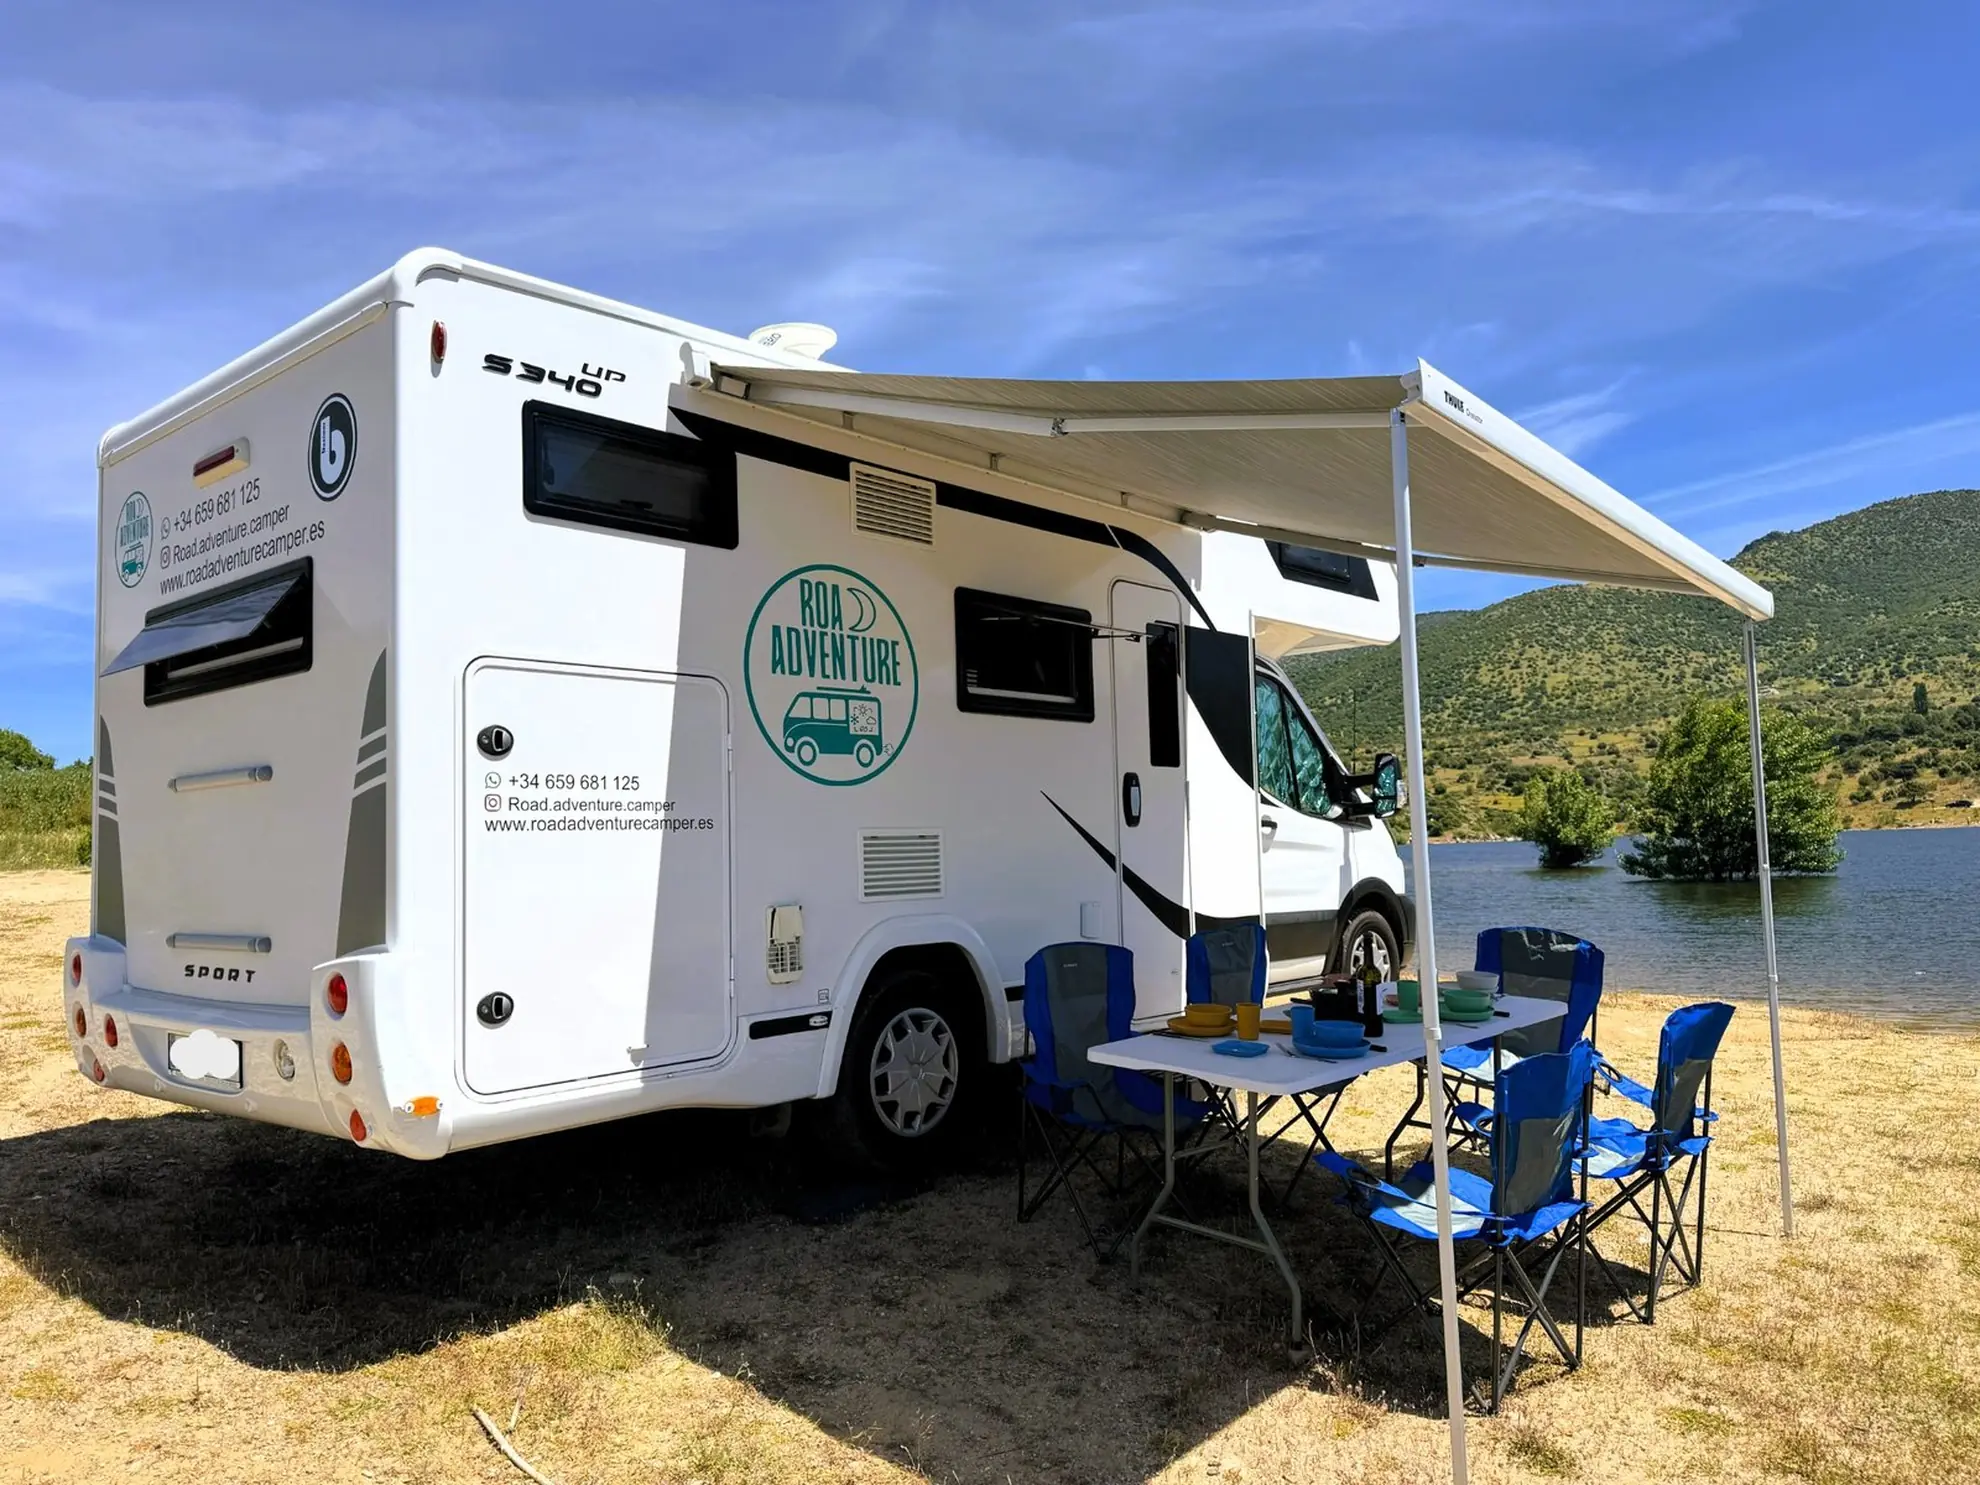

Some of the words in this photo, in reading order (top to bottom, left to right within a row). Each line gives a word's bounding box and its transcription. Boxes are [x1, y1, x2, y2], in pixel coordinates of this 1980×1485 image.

[481, 353, 603, 398] S340
[174, 508, 192, 532] +34
[194, 498, 215, 526] 659
[217, 487, 237, 516] 681
[240, 477, 261, 506] 125
[159, 520, 325, 596] www.roadadventurecamper.es
[173, 504, 291, 565] Road.adventure.camper
[799, 578, 844, 632] ROA
[771, 624, 902, 687] ADVENTURE
[508, 773, 539, 790] +34
[545, 774, 575, 790] 659
[580, 775, 608, 791] 681
[613, 775, 640, 791] 125
[508, 796, 676, 815] Road.adventure.camper
[484, 816, 714, 833] www.roadadventurecamper.es
[184, 964, 257, 983] SPORT
